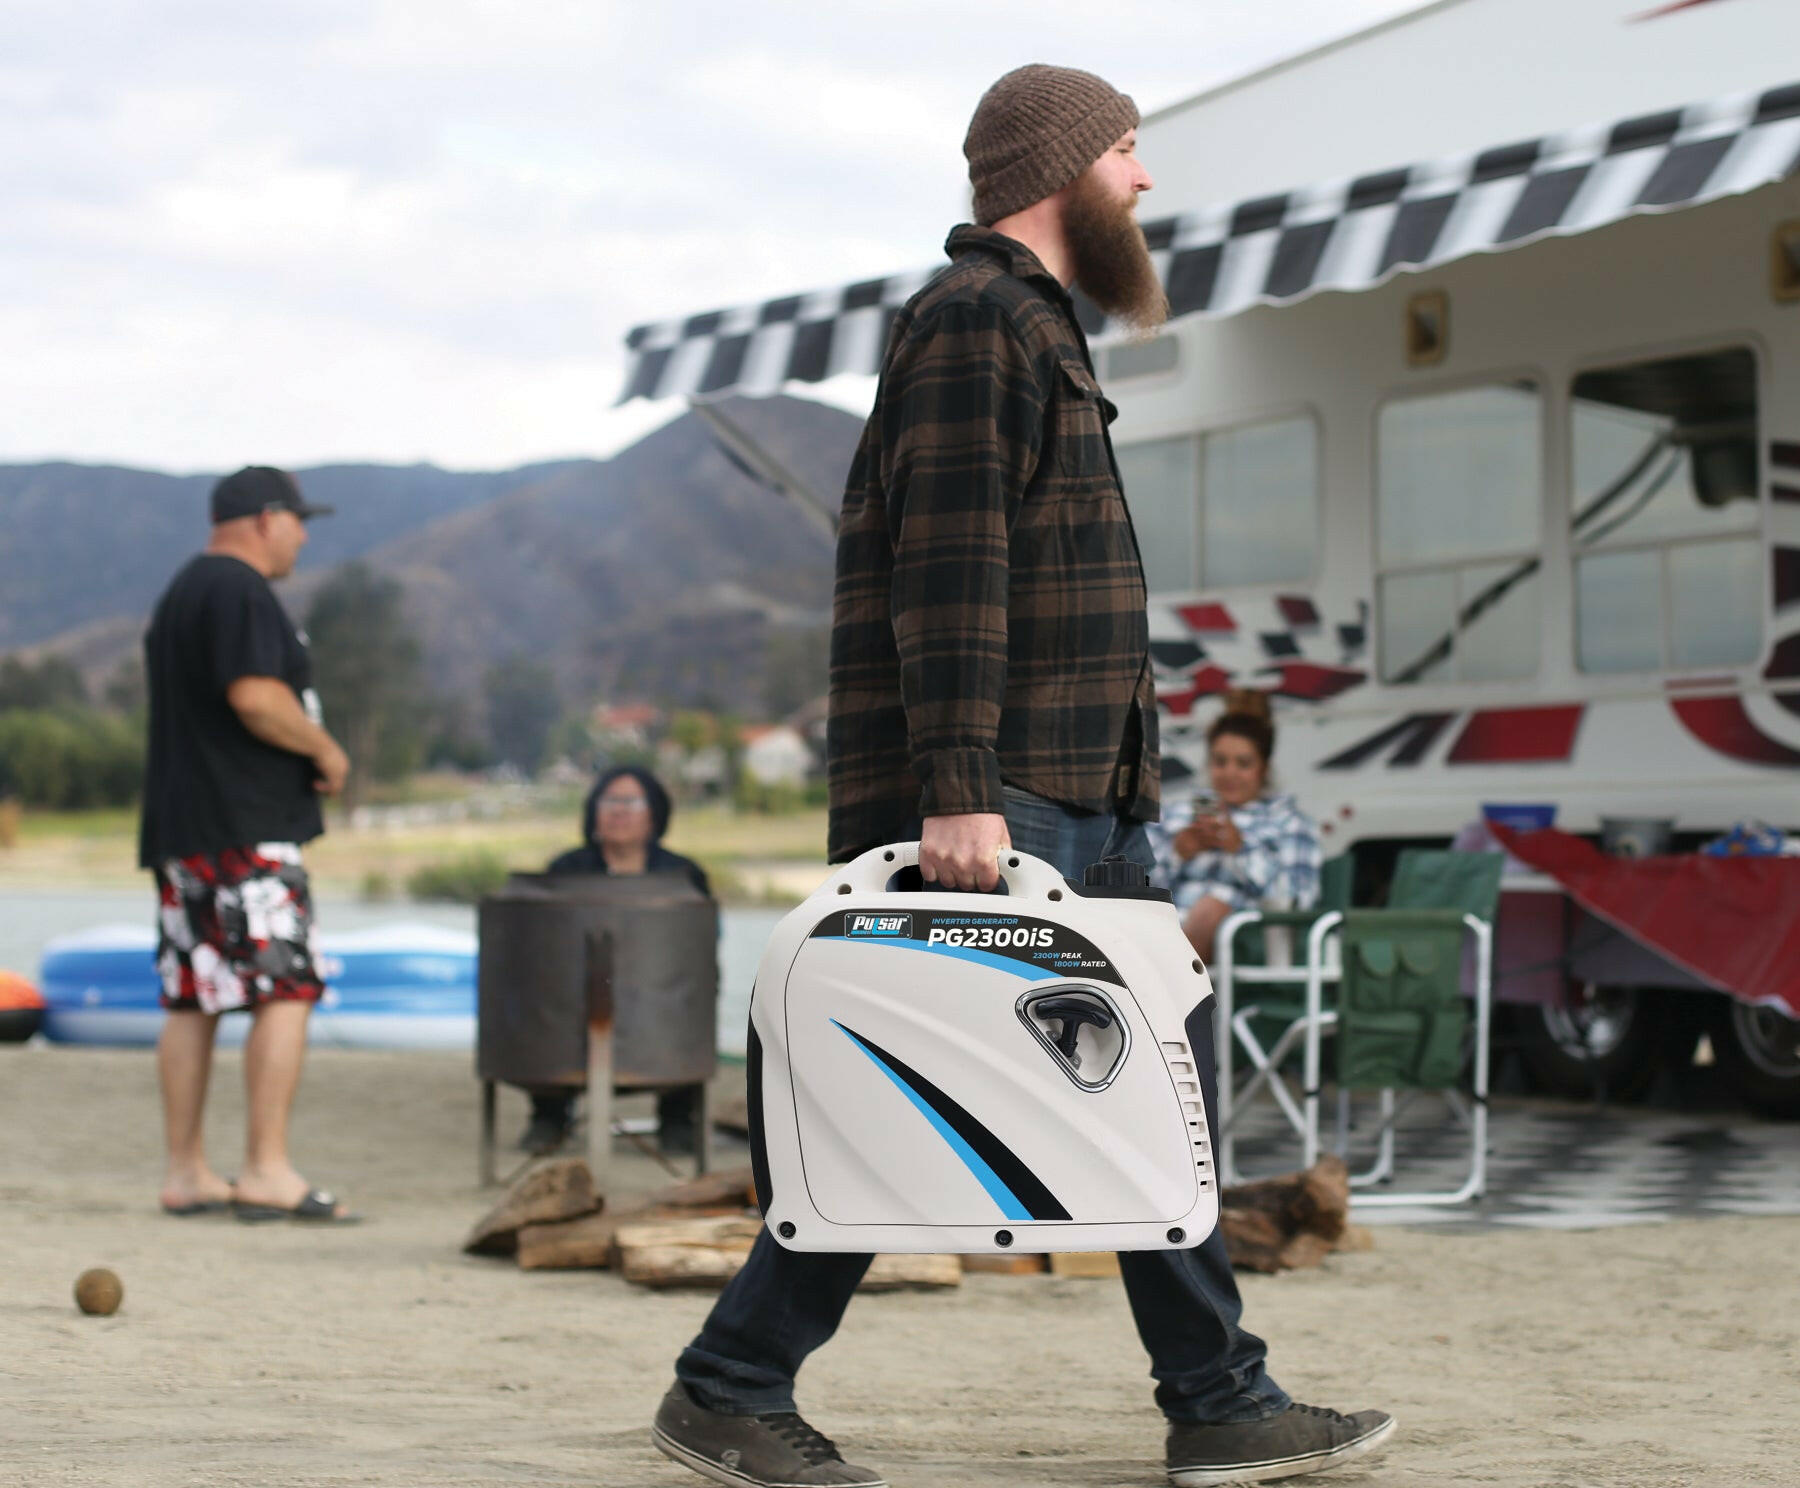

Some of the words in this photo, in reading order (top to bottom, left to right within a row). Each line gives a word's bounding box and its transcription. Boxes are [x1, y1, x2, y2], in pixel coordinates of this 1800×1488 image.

[852, 916, 908, 935] Pulsar
[927, 928, 1054, 947] PG2300iS
[1054, 960, 1079, 968] 1800W
[1081, 960, 1106, 968] RATED
